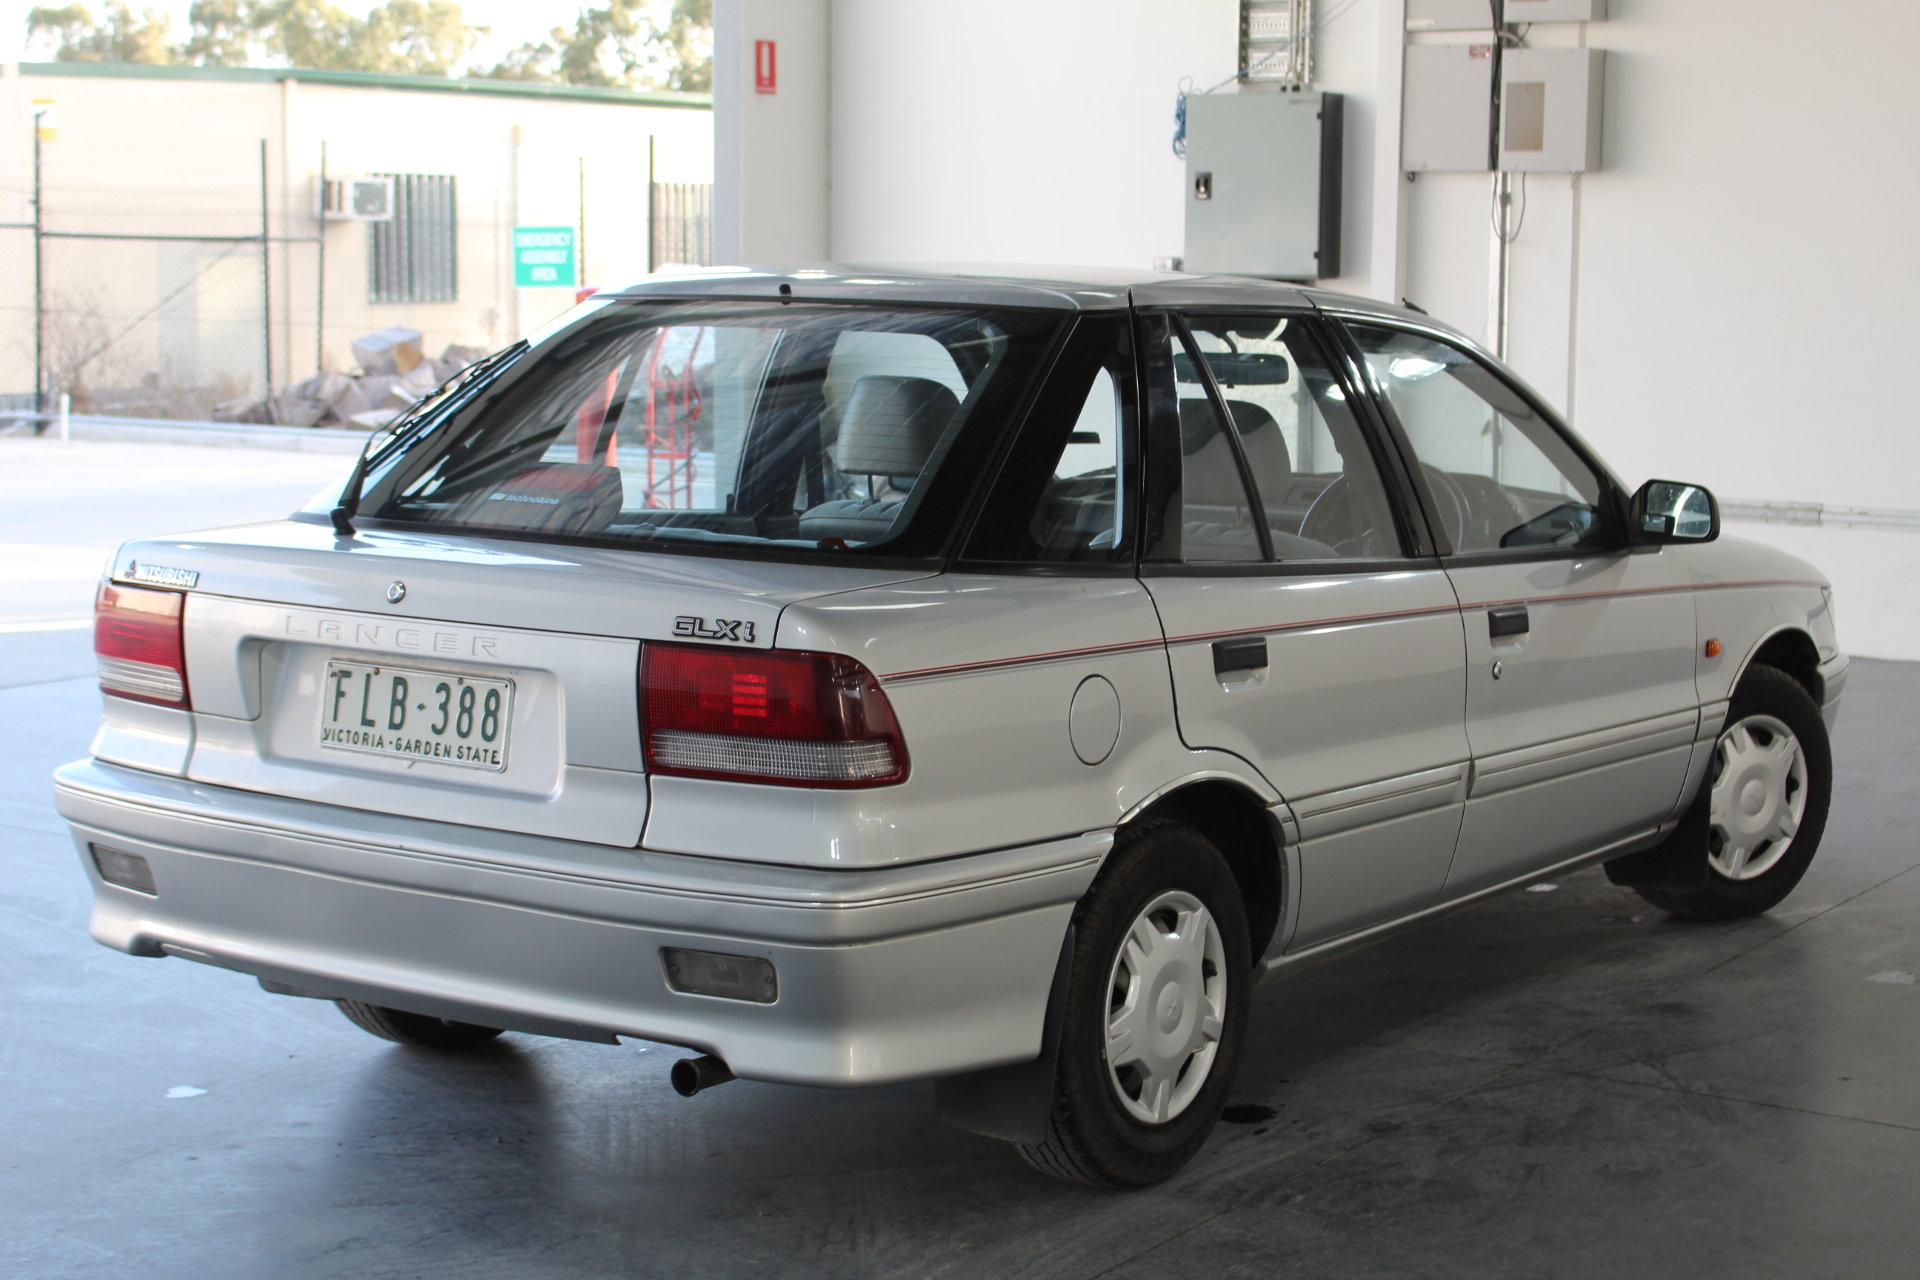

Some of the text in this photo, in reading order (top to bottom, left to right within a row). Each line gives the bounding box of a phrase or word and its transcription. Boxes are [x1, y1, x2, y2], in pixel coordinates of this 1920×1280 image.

[136, 564, 199, 587] MITSUBISHI
[286, 615, 501, 658] LANCER
[456, 745, 501, 765] STATE
